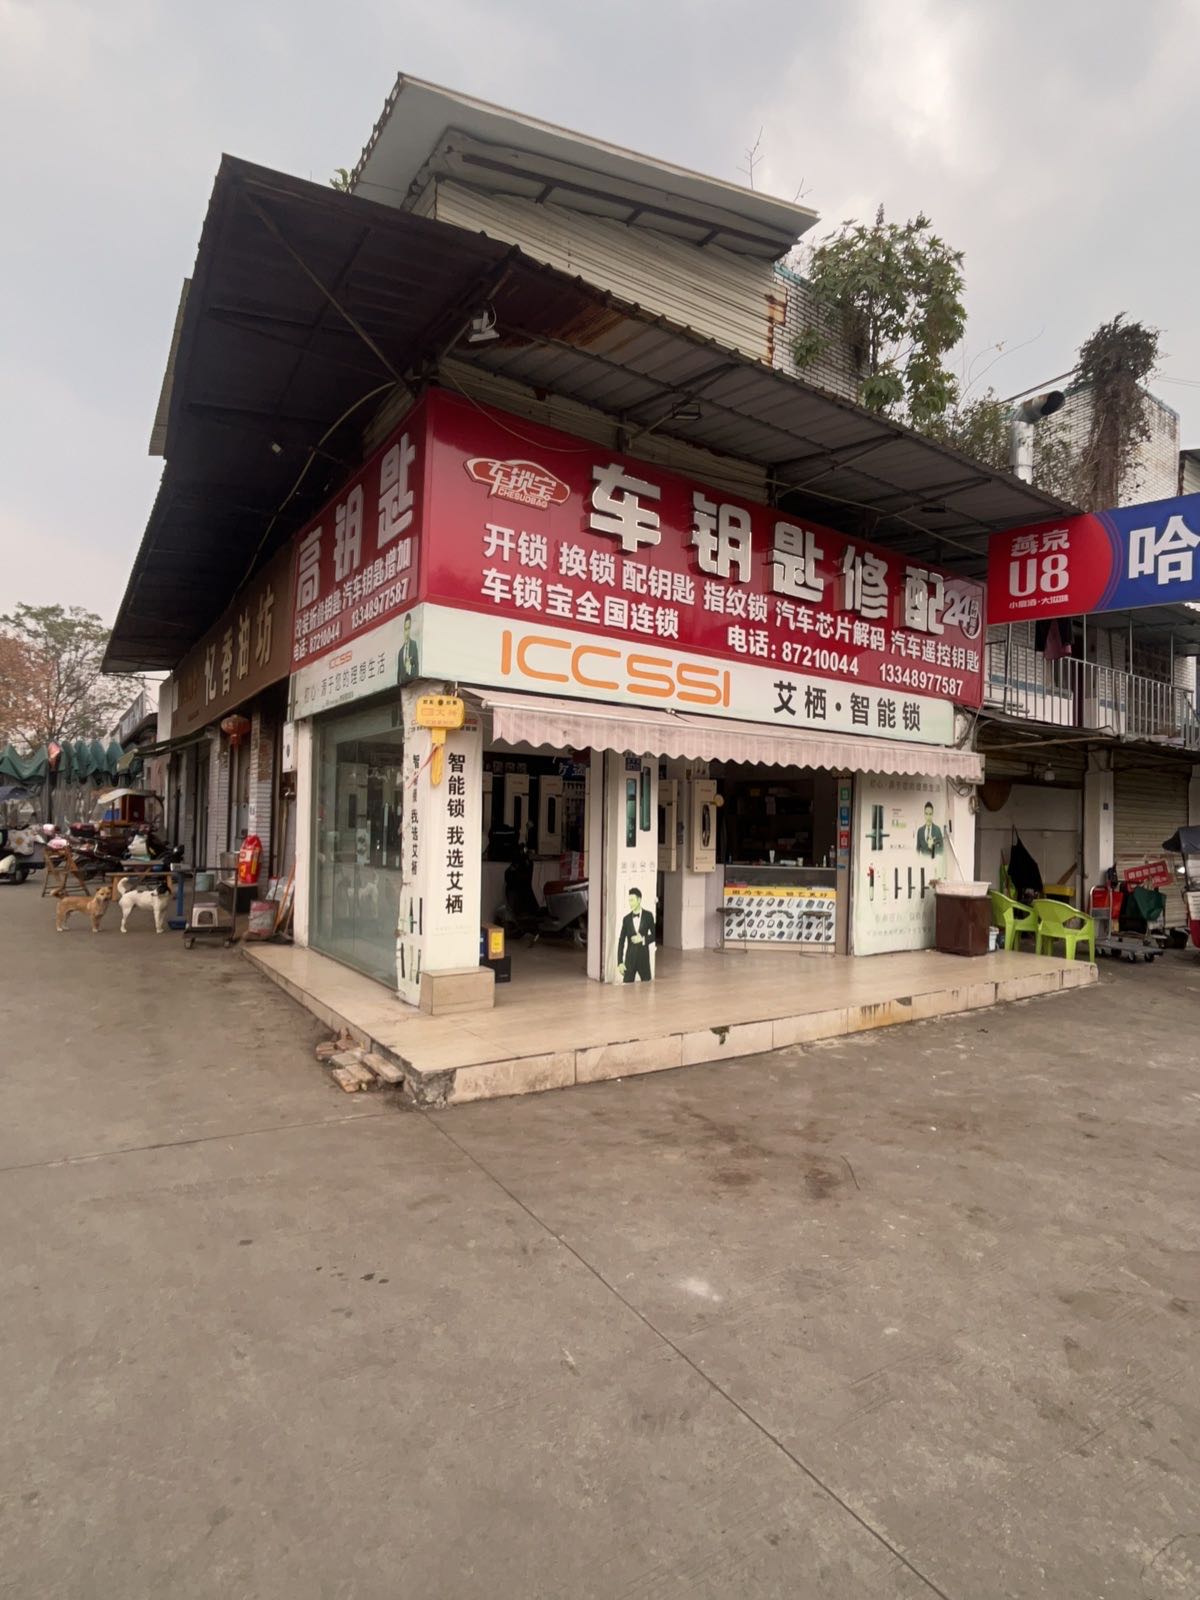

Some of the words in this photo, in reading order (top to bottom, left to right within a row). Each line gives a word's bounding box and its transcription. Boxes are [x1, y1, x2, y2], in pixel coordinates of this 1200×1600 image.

[488, 462, 557, 500] 车锁宝
[589, 462, 945, 635] 车钥匙修配
[1009, 554, 1069, 597] U8
[1010, 529, 1070, 557] 燕京
[1128, 515, 1200, 585] 哈
[481, 567, 680, 640] 车锁宝全国连锁
[483, 522, 548, 570] 开锁
[559, 542, 616, 588] 换锁
[622, 560, 696, 606] 配钥匙
[703, 582, 768, 624] 指纹锁
[776, 600, 885, 653] 汽车芯片解码
[891, 630, 980, 673] 汽车遥控钥匙
[880, 663, 964, 697] 13348977587
[447, 752, 466, 819] 智能锁
[445, 825, 465, 915] 我选艾栖
